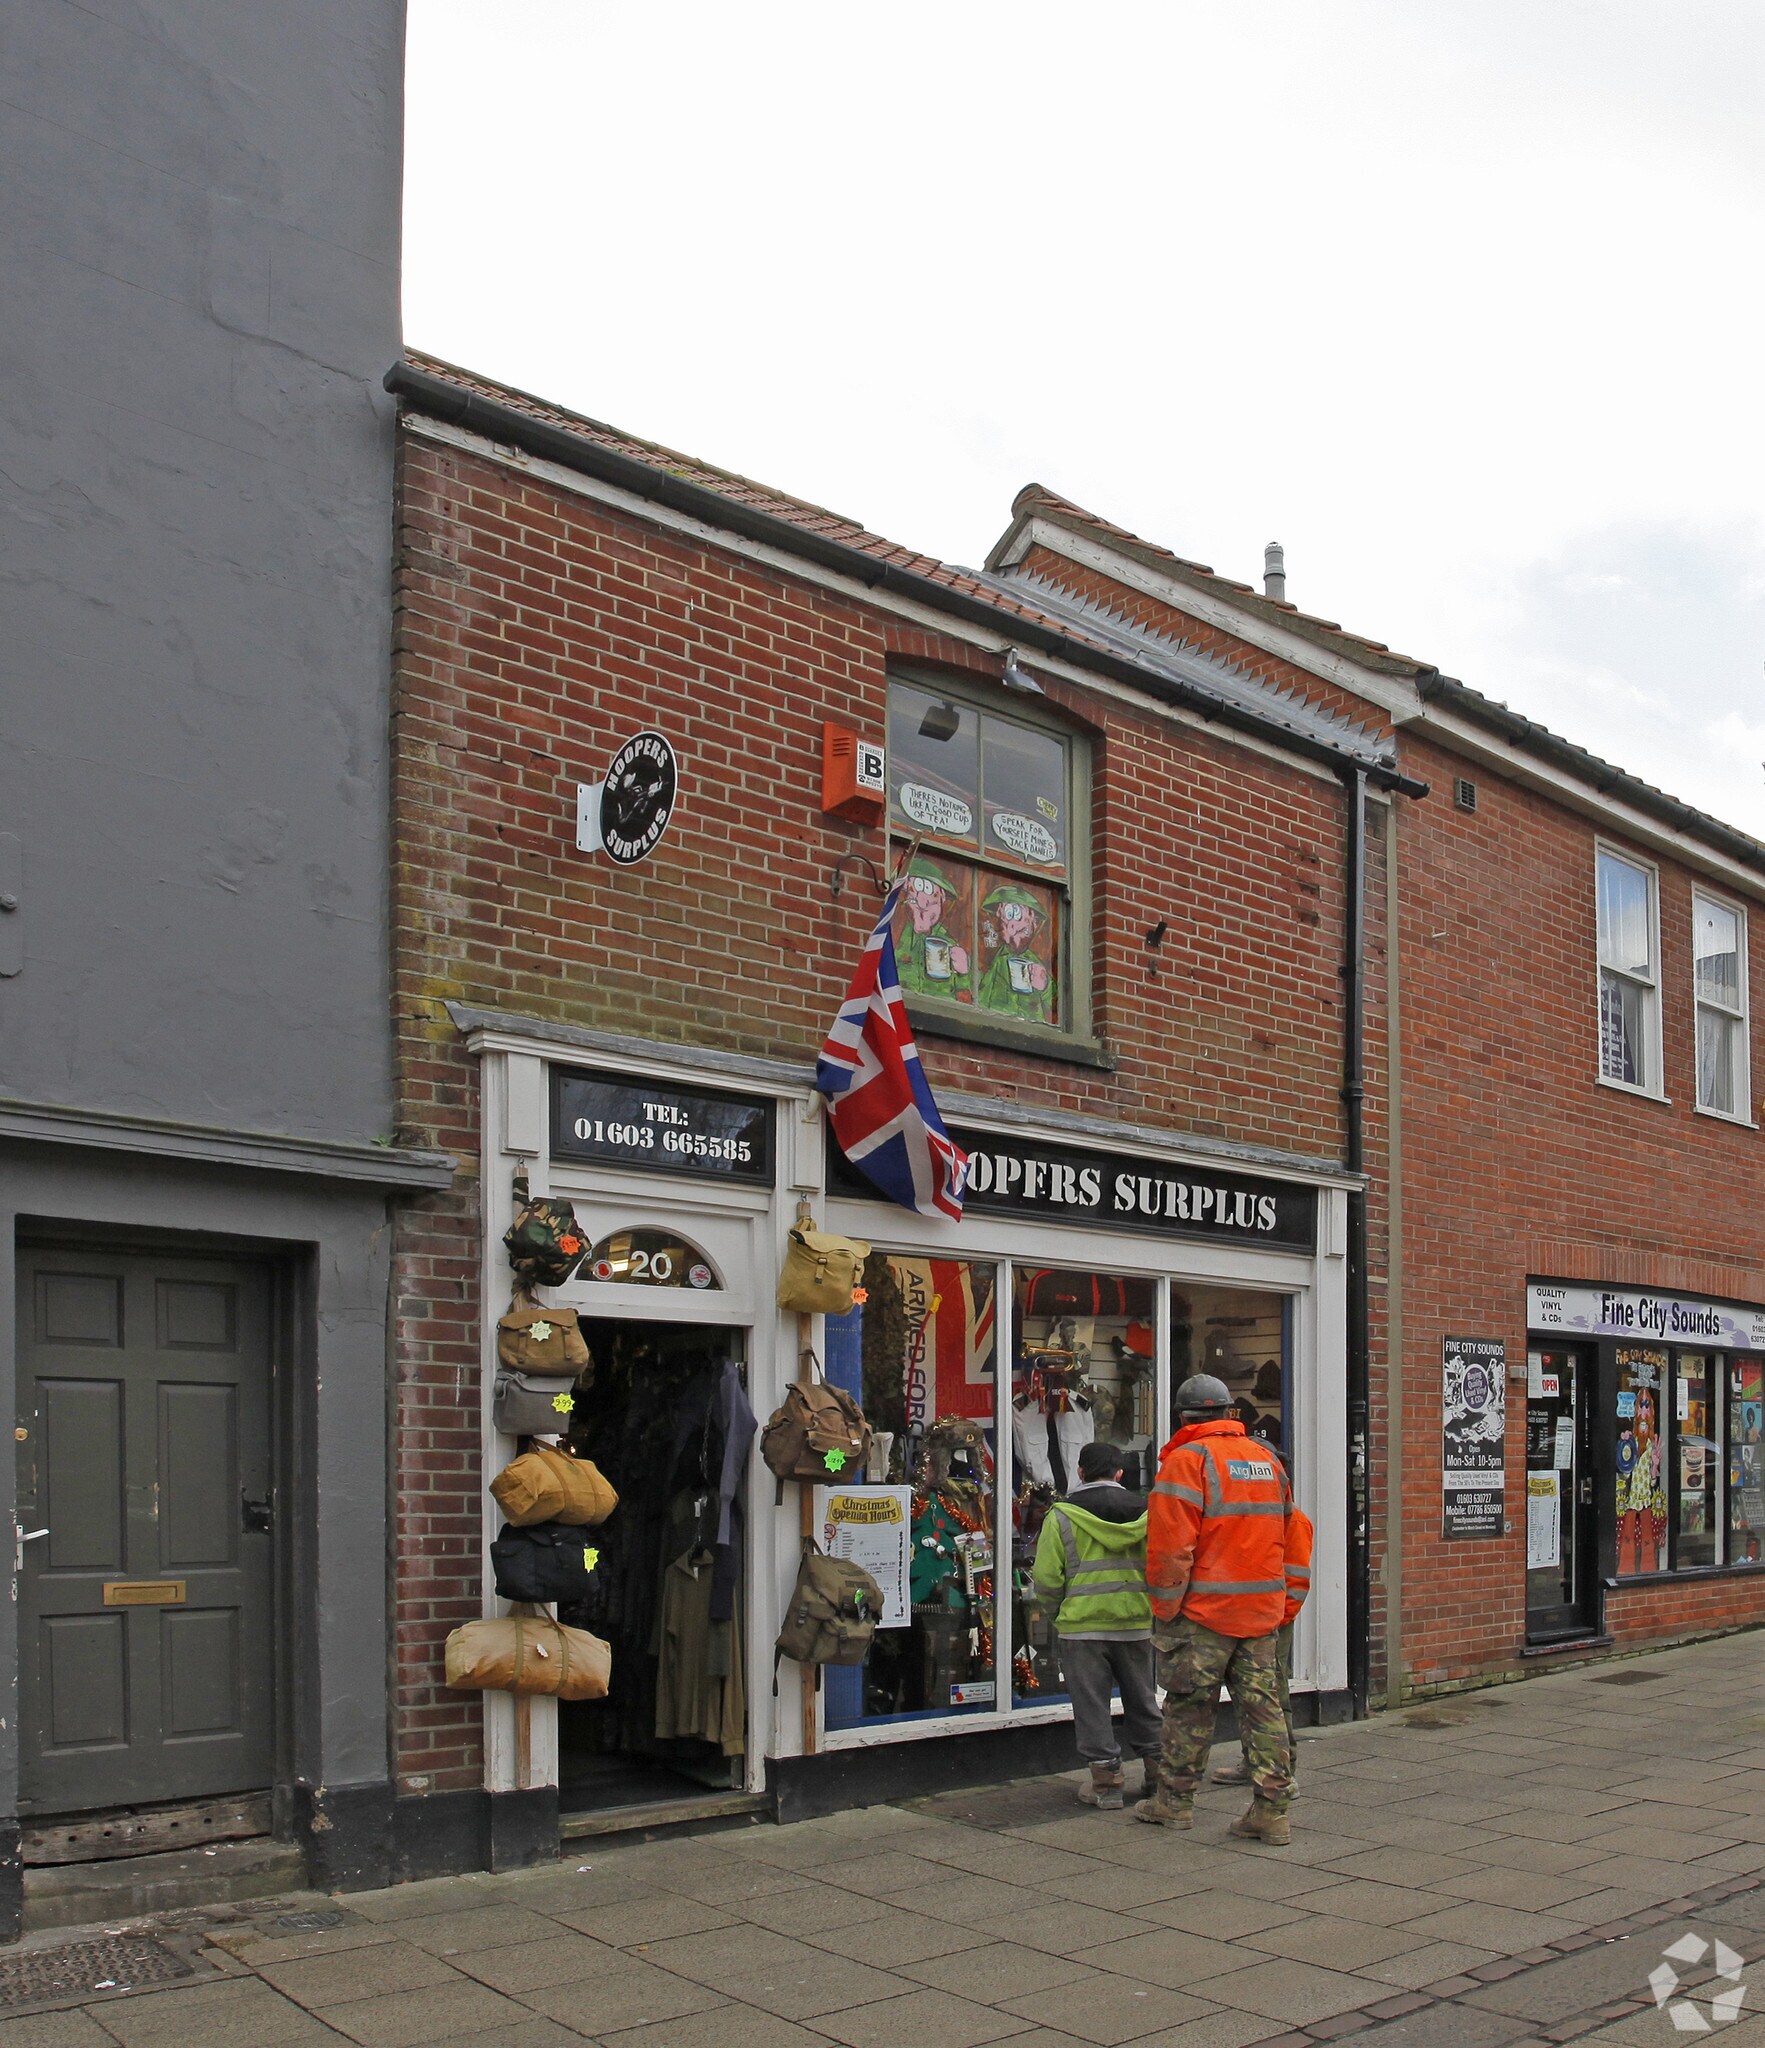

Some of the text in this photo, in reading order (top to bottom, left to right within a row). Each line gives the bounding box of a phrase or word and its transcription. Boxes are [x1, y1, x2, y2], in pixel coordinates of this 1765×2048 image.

[606, 738, 668, 792] HOOPERS
[864, 752, 883, 779] B
[909, 797, 969, 826] LIKE A GOOD CUP
[913, 811, 925, 821] OF
[606, 807, 667, 859] SURPLUS
[995, 822, 1030, 843] YOURSELF
[1000, 815, 1043, 837] SPEAK FOR
[1008, 836, 1029, 852] JACK
[642, 1102, 689, 1127] TEL:
[574, 1117, 752, 1162] 01603 665585
[965, 1151, 1278, 1232] OPERS SURPLUS
[630, 1250, 673, 1280] 20
[1536, 1288, 1567, 1299] QUALITY
[1540, 1300, 1562, 1311] VINYL
[1541, 1312, 1562, 1323] & CDs
[1601, 1293, 1721, 1338] Fine City Sounds
[906, 1268, 926, 1438] ARMED FORC
[1446, 1341, 1504, 1356] FINE CITY SOUNDS
[1541, 1379, 1558, 1392] OPEN
[1469, 1445, 1480, 1453] Open
[1446, 1454, 1502, 1469] Mon-Sat 10-5pm
[842, 1498, 891, 1511] Christmas
[1456, 1493, 1473, 1504] 01603
[831, 1506, 897, 1522] Opening Hours
[1445, 1504, 1467, 1516] Mobile:
